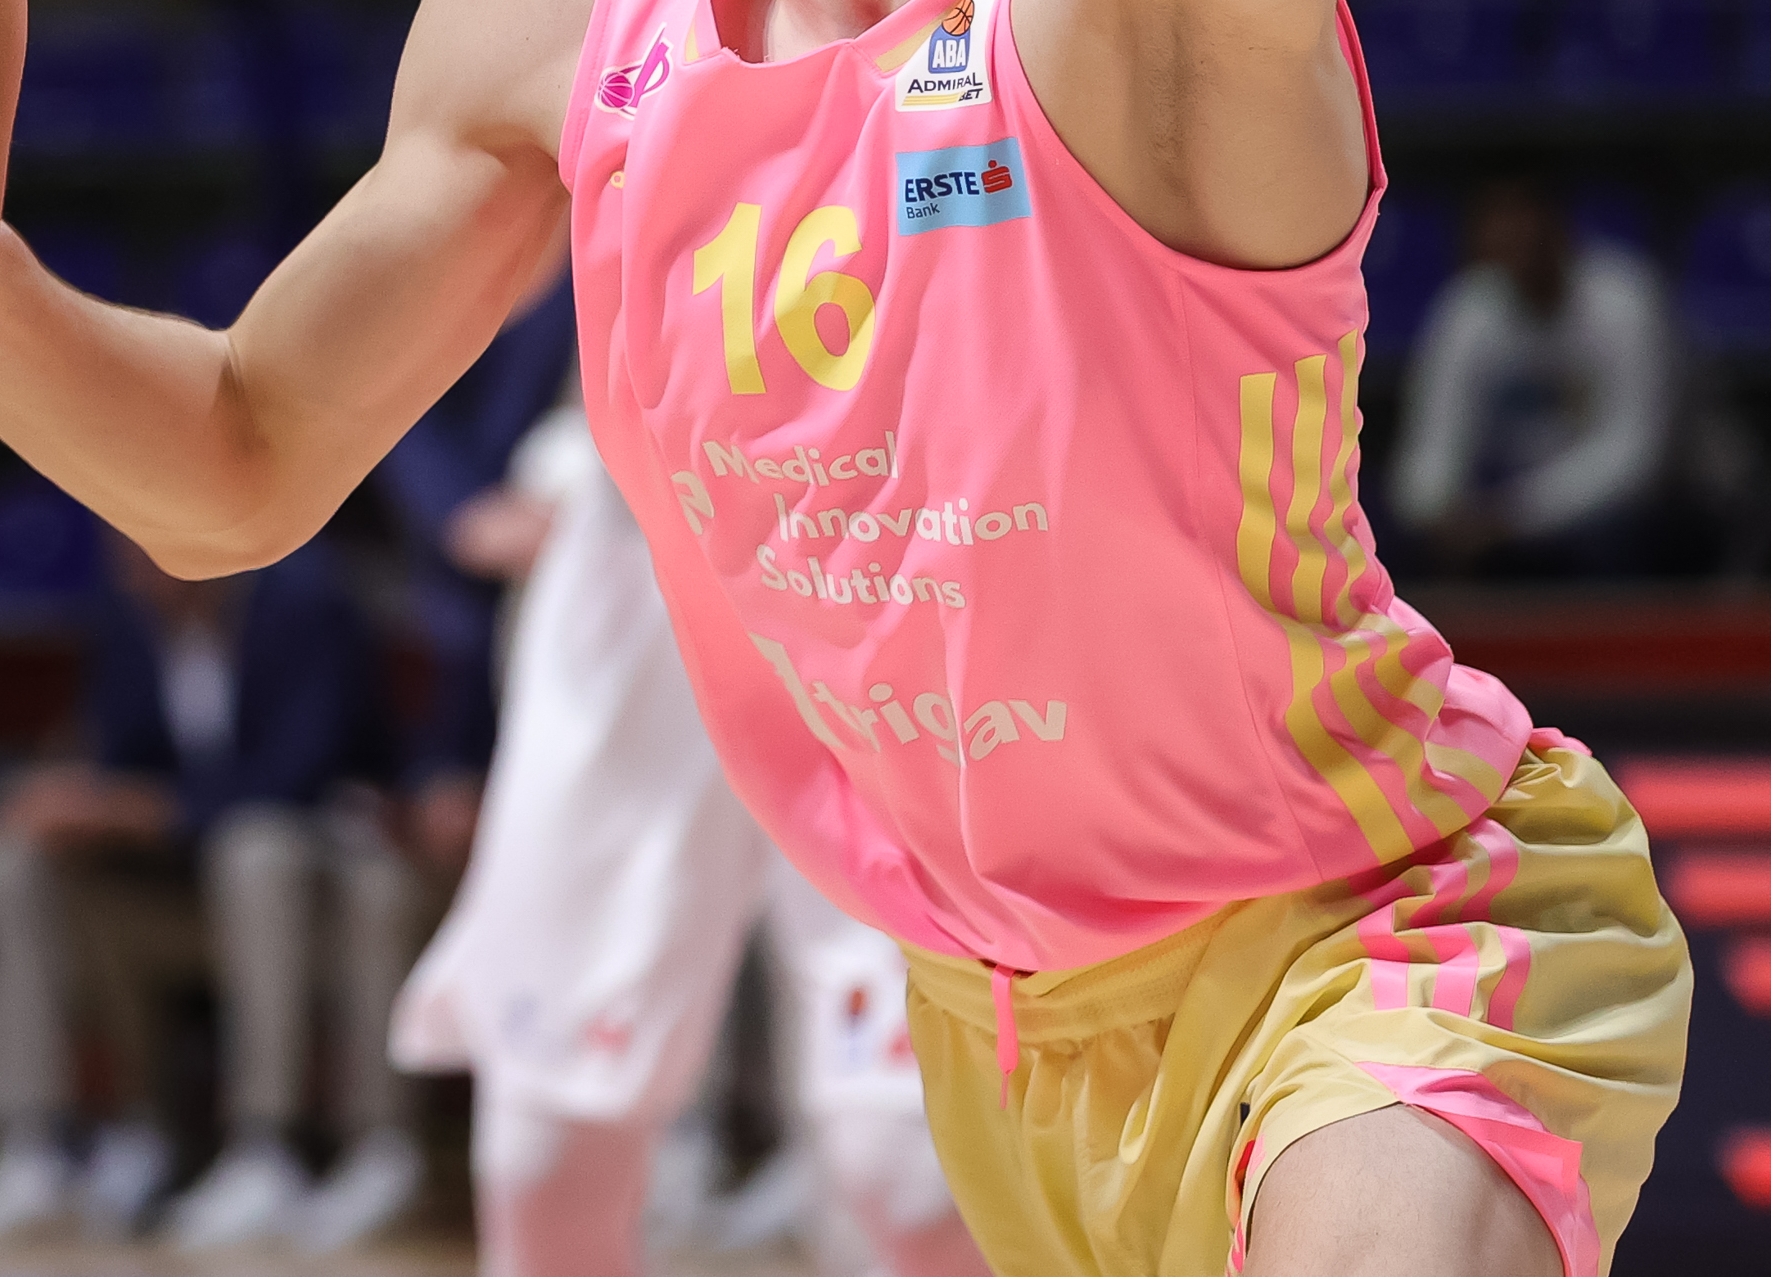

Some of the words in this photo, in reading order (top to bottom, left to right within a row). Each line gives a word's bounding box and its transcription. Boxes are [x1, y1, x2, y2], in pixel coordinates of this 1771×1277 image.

[932, 38, 966, 69] ABA
[907, 72, 983, 94] ADMIRAL
[904, 171, 980, 203] ERSTE
[906, 203, 940, 219] Bank
[692, 202, 876, 395] 16
[702, 431, 899, 486] Medical
[773, 492, 1048, 545] Innovation
[756, 543, 966, 609] Solutions
